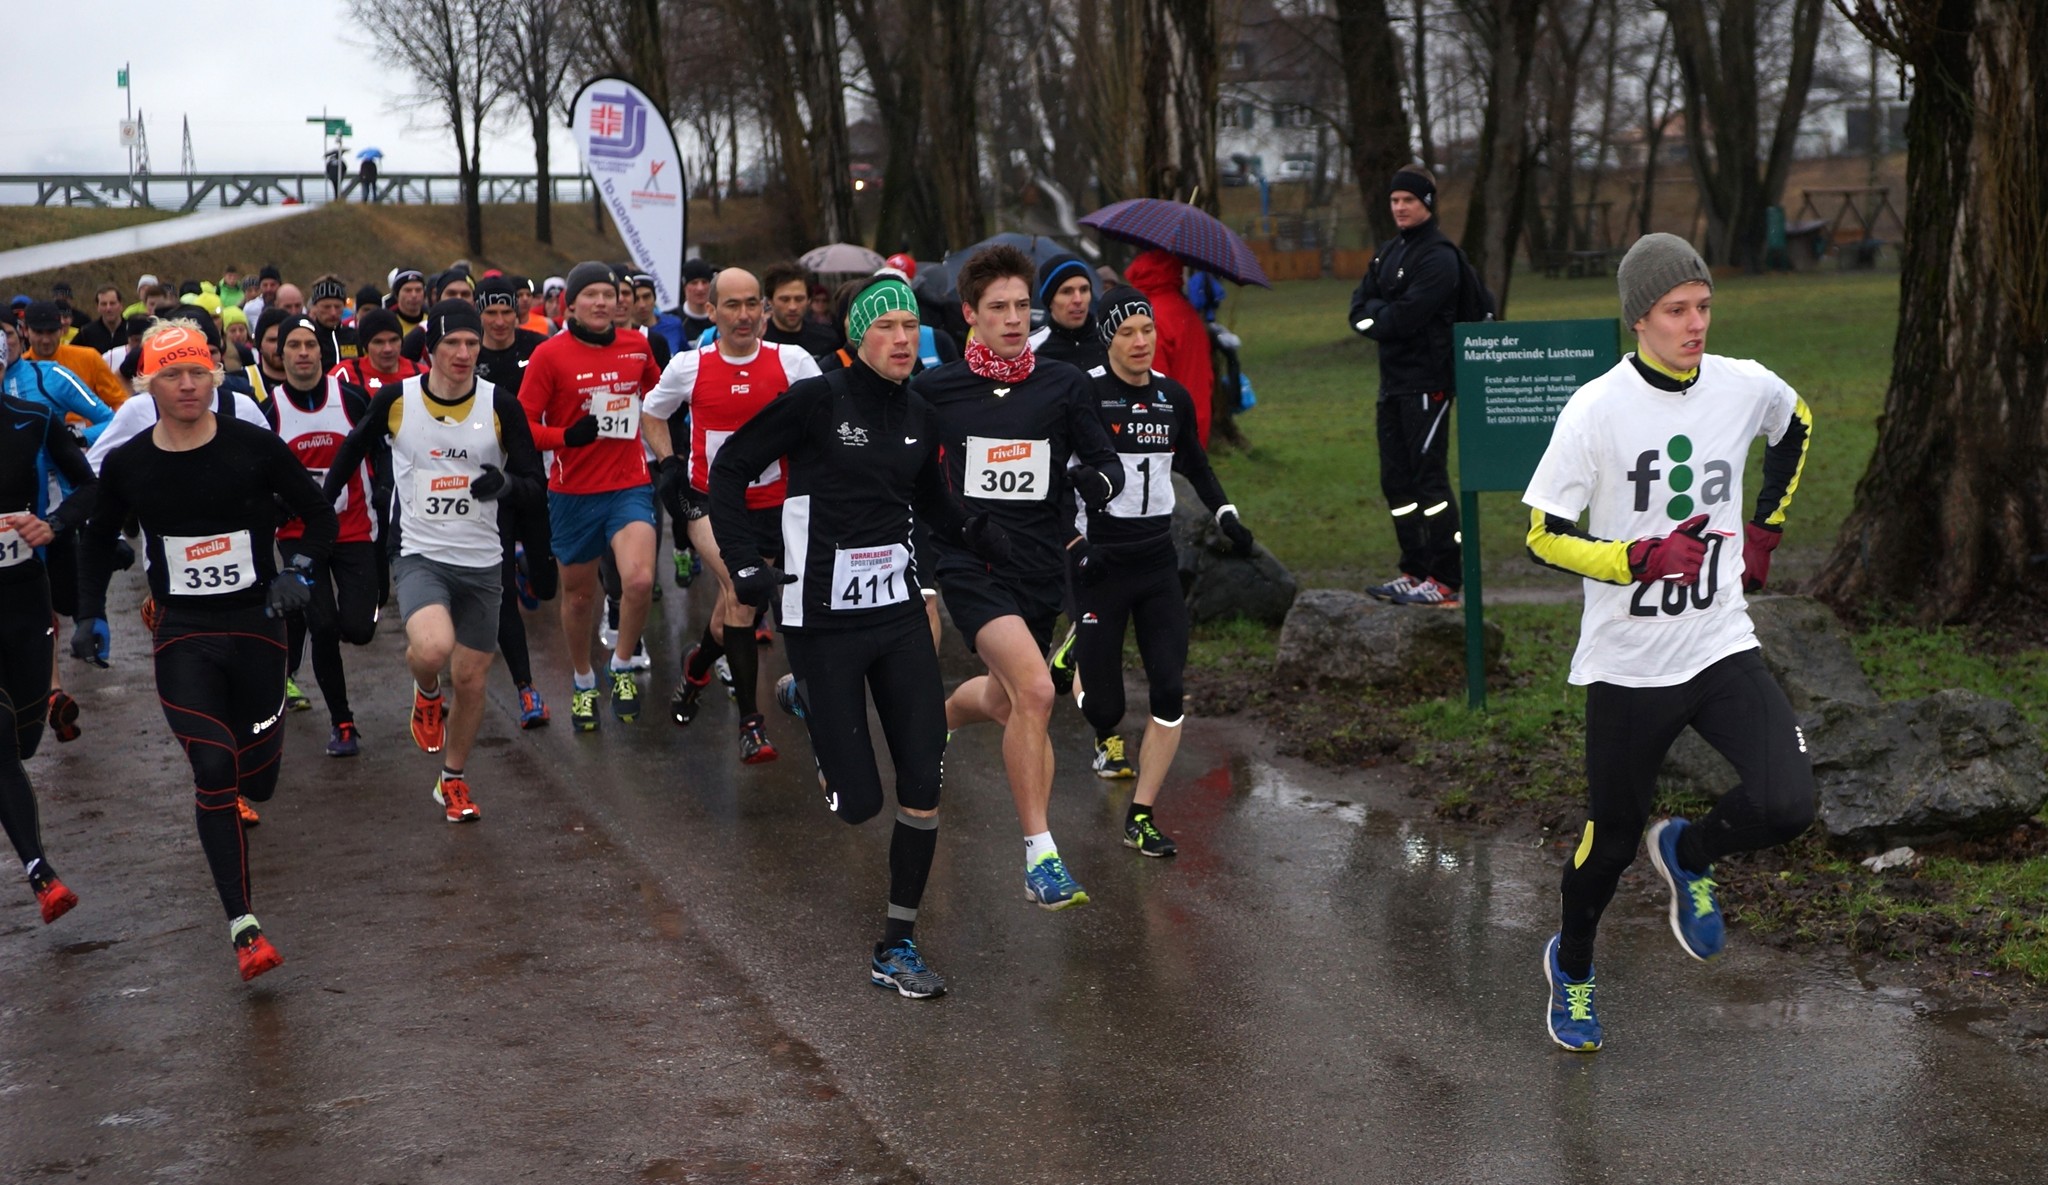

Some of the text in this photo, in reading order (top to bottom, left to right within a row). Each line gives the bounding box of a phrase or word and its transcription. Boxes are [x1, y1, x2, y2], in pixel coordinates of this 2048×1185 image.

[1464, 336, 1519, 347] Anlage der
[1464, 348, 1595, 362] Marktgemeinde Lustenau
[1485, 376, 1503, 384] Feste
[1504, 375, 1520, 383] aller
[1534, 374, 1549, 382] sind
[1534, 385, 1545, 393] der
[1486, 396, 1517, 404] Lustenau
[1487, 415, 1497, 424] Tel
[1127, 423, 1170, 435] SPORT
[992, 444, 1027, 459] rivella
[436, 478, 464, 489] rivella
[981, 469, 1035, 493] 302
[1137, 457, 1150, 515] 1
[425, 497, 470, 516] 376
[191, 540, 226, 557] rivella
[851, 549, 892, 560] VORARLBERGER
[184, 563, 240, 589] 335
[842, 571, 896, 606] 411
